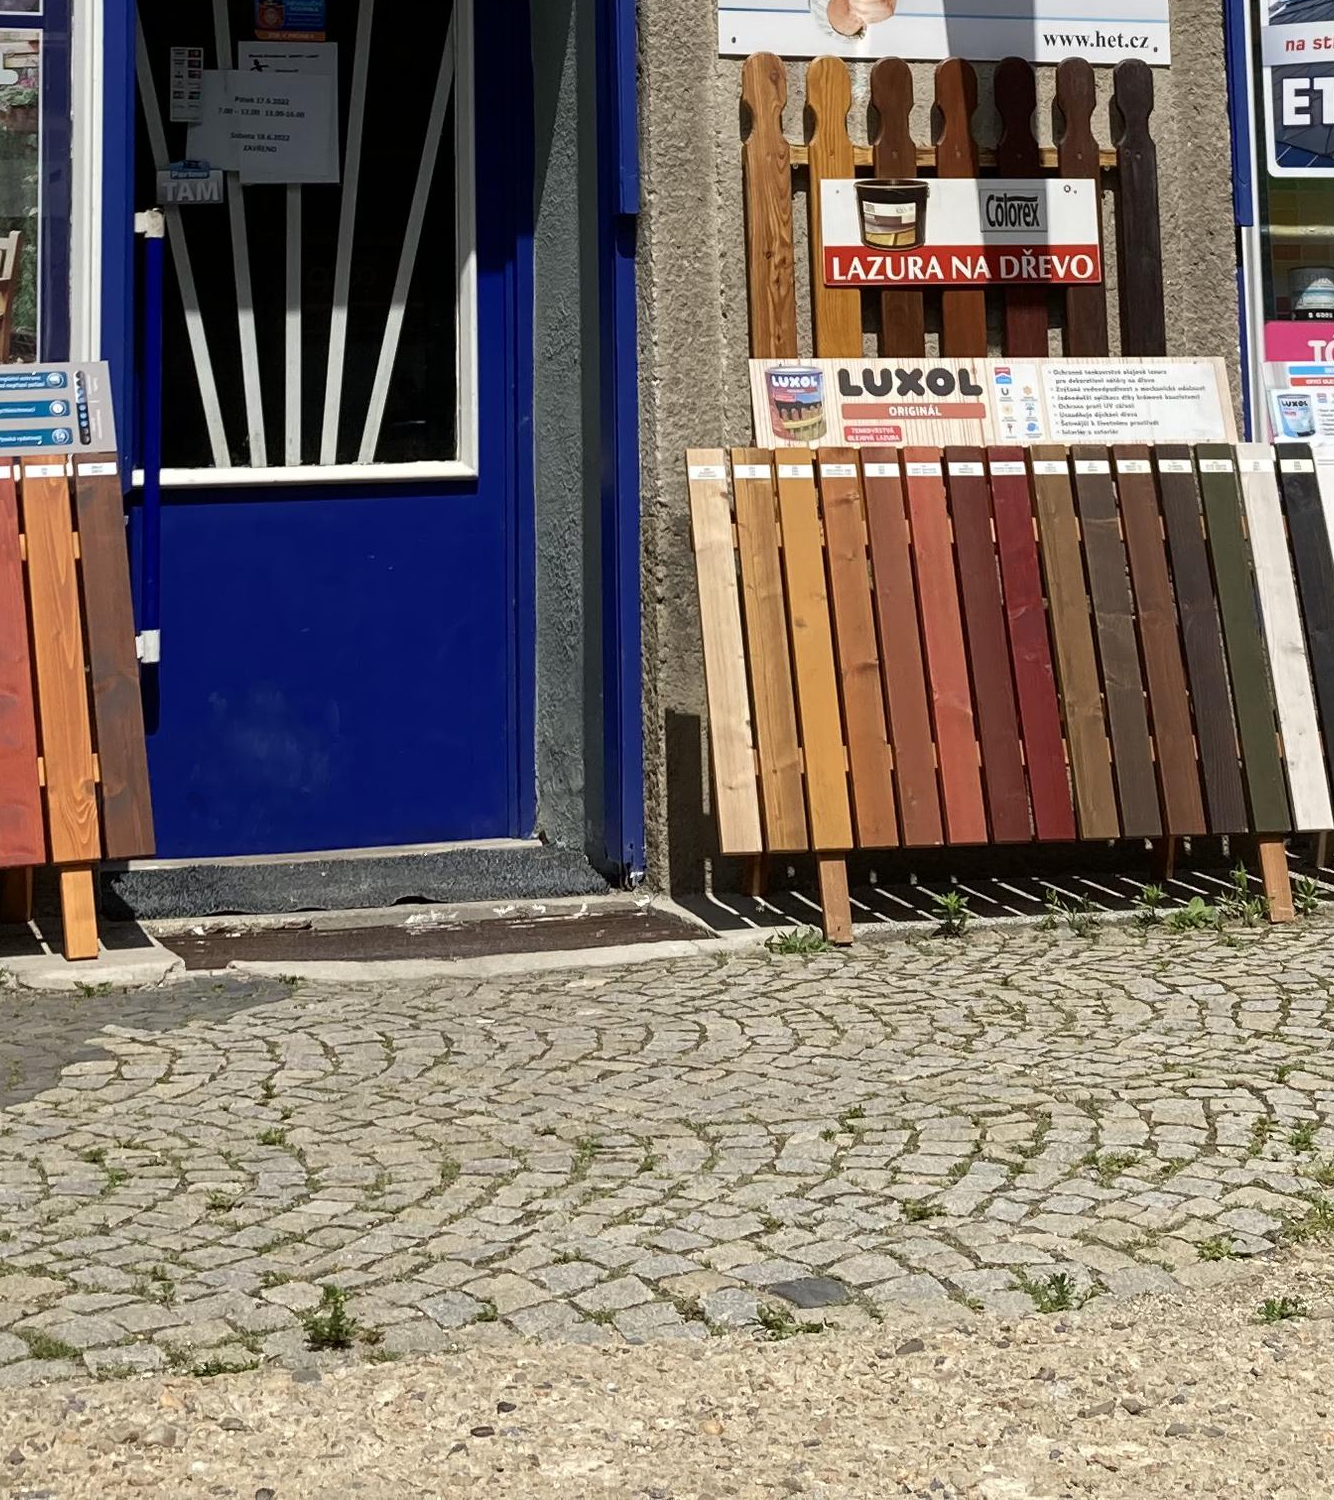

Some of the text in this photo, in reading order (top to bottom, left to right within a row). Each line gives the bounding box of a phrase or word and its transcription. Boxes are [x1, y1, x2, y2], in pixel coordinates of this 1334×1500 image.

[1042, 28, 1150, 51] www.het.cz
[1285, 38, 1305, 53] na
[162, 181, 220, 201] TAM
[985, 193, 1040, 229] Colorex
[831, 248, 1095, 281] LAZURA NA DŘEVO
[771, 375, 818, 388] LUXOL
[837, 367, 984, 397] LUXOL
[888, 405, 943, 417] ORIGINÁL
